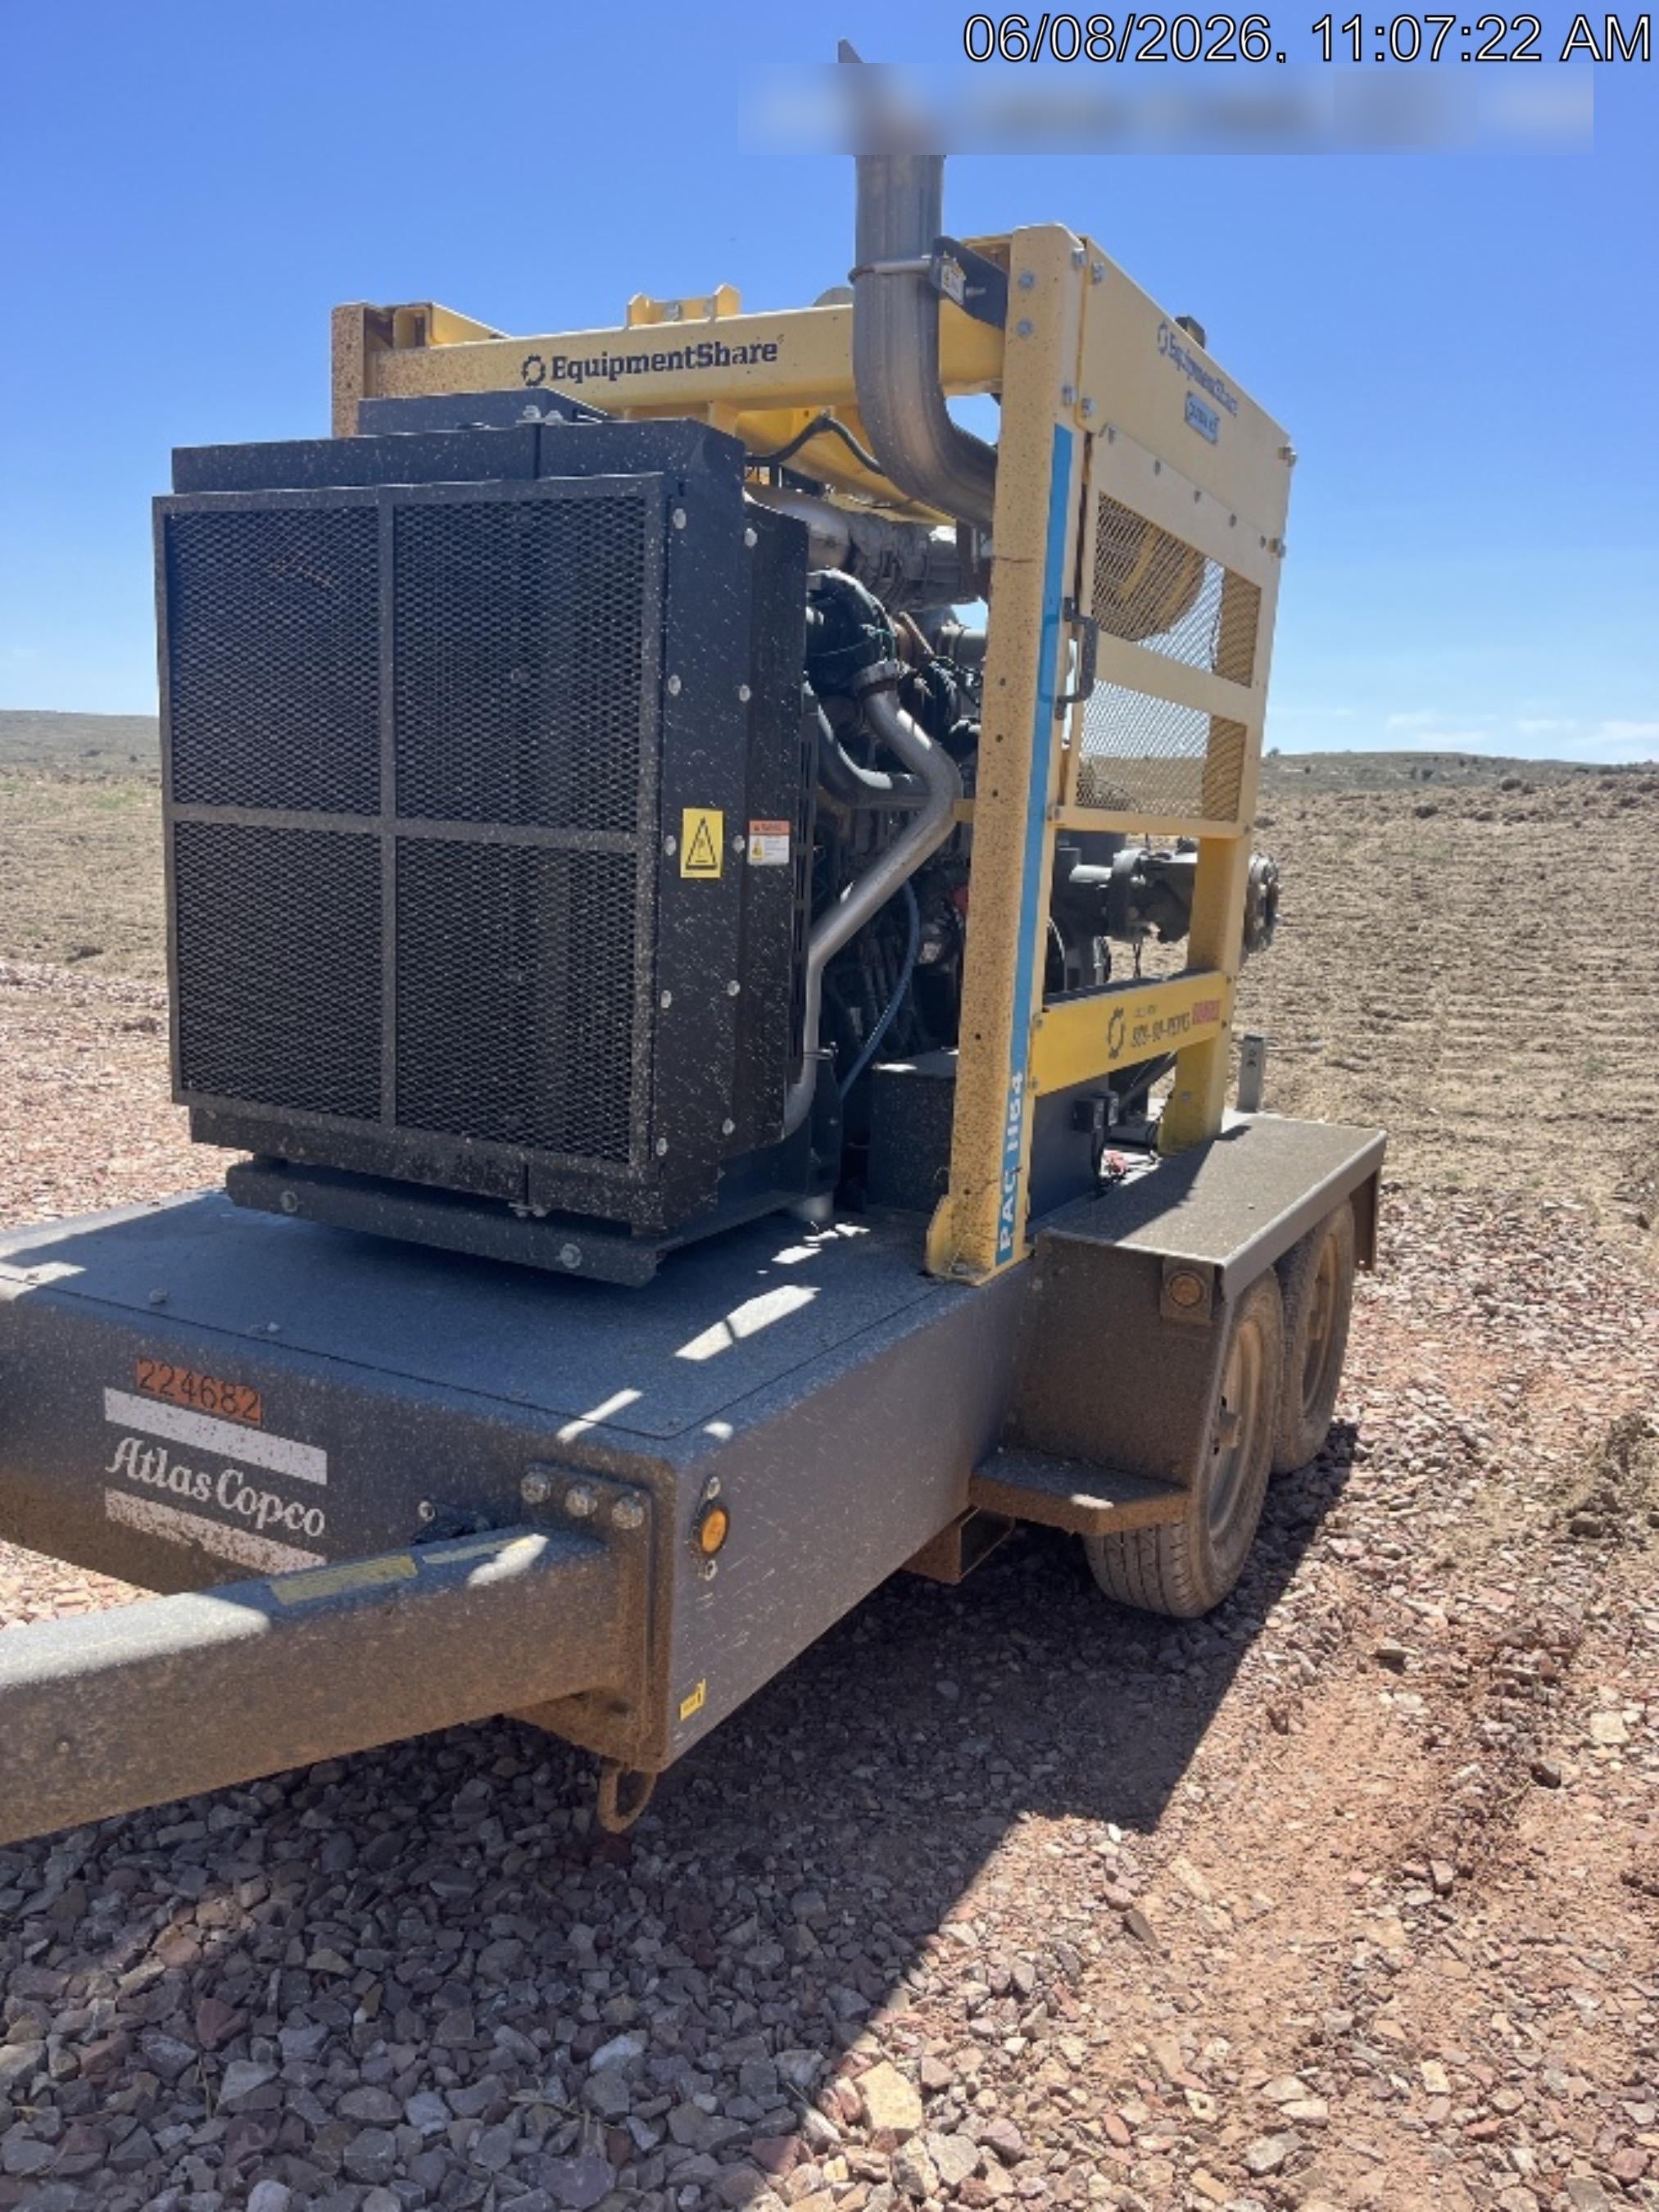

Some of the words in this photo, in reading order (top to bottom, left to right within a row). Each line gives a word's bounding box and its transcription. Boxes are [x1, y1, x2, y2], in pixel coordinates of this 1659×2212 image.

[552, 340, 778, 383] EquipmentShare
[138, 1358, 259, 1422] 224682
[106, 1437, 212, 1503] Atlas
[216, 1468, 325, 1538] Copco
